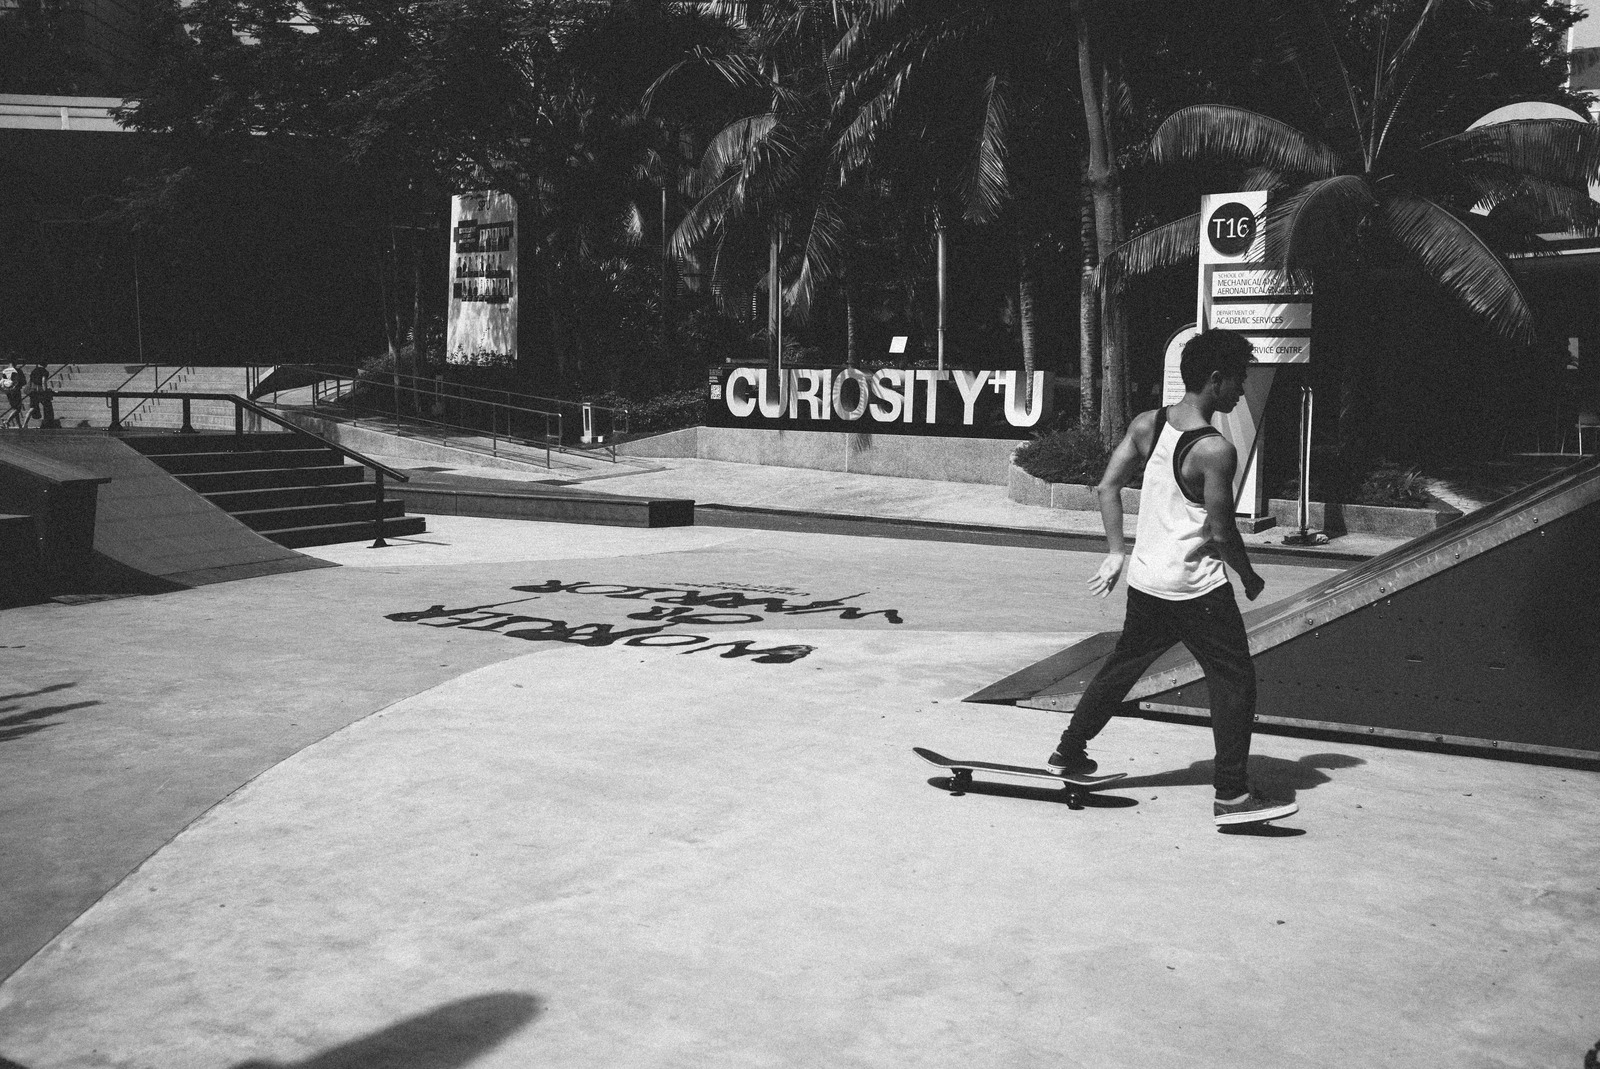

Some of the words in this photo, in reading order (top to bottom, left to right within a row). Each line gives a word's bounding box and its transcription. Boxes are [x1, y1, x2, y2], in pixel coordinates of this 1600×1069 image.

[1212, 217, 1250, 239] T16
[1217, 278, 1260, 287] MECHANICAL
[1217, 286, 1266, 295] AERONAUTICAL
[1251, 316, 1284, 324] SERVICES
[1252, 346, 1274, 354] RVICE
[1275, 346, 1303, 354] CENTRE
